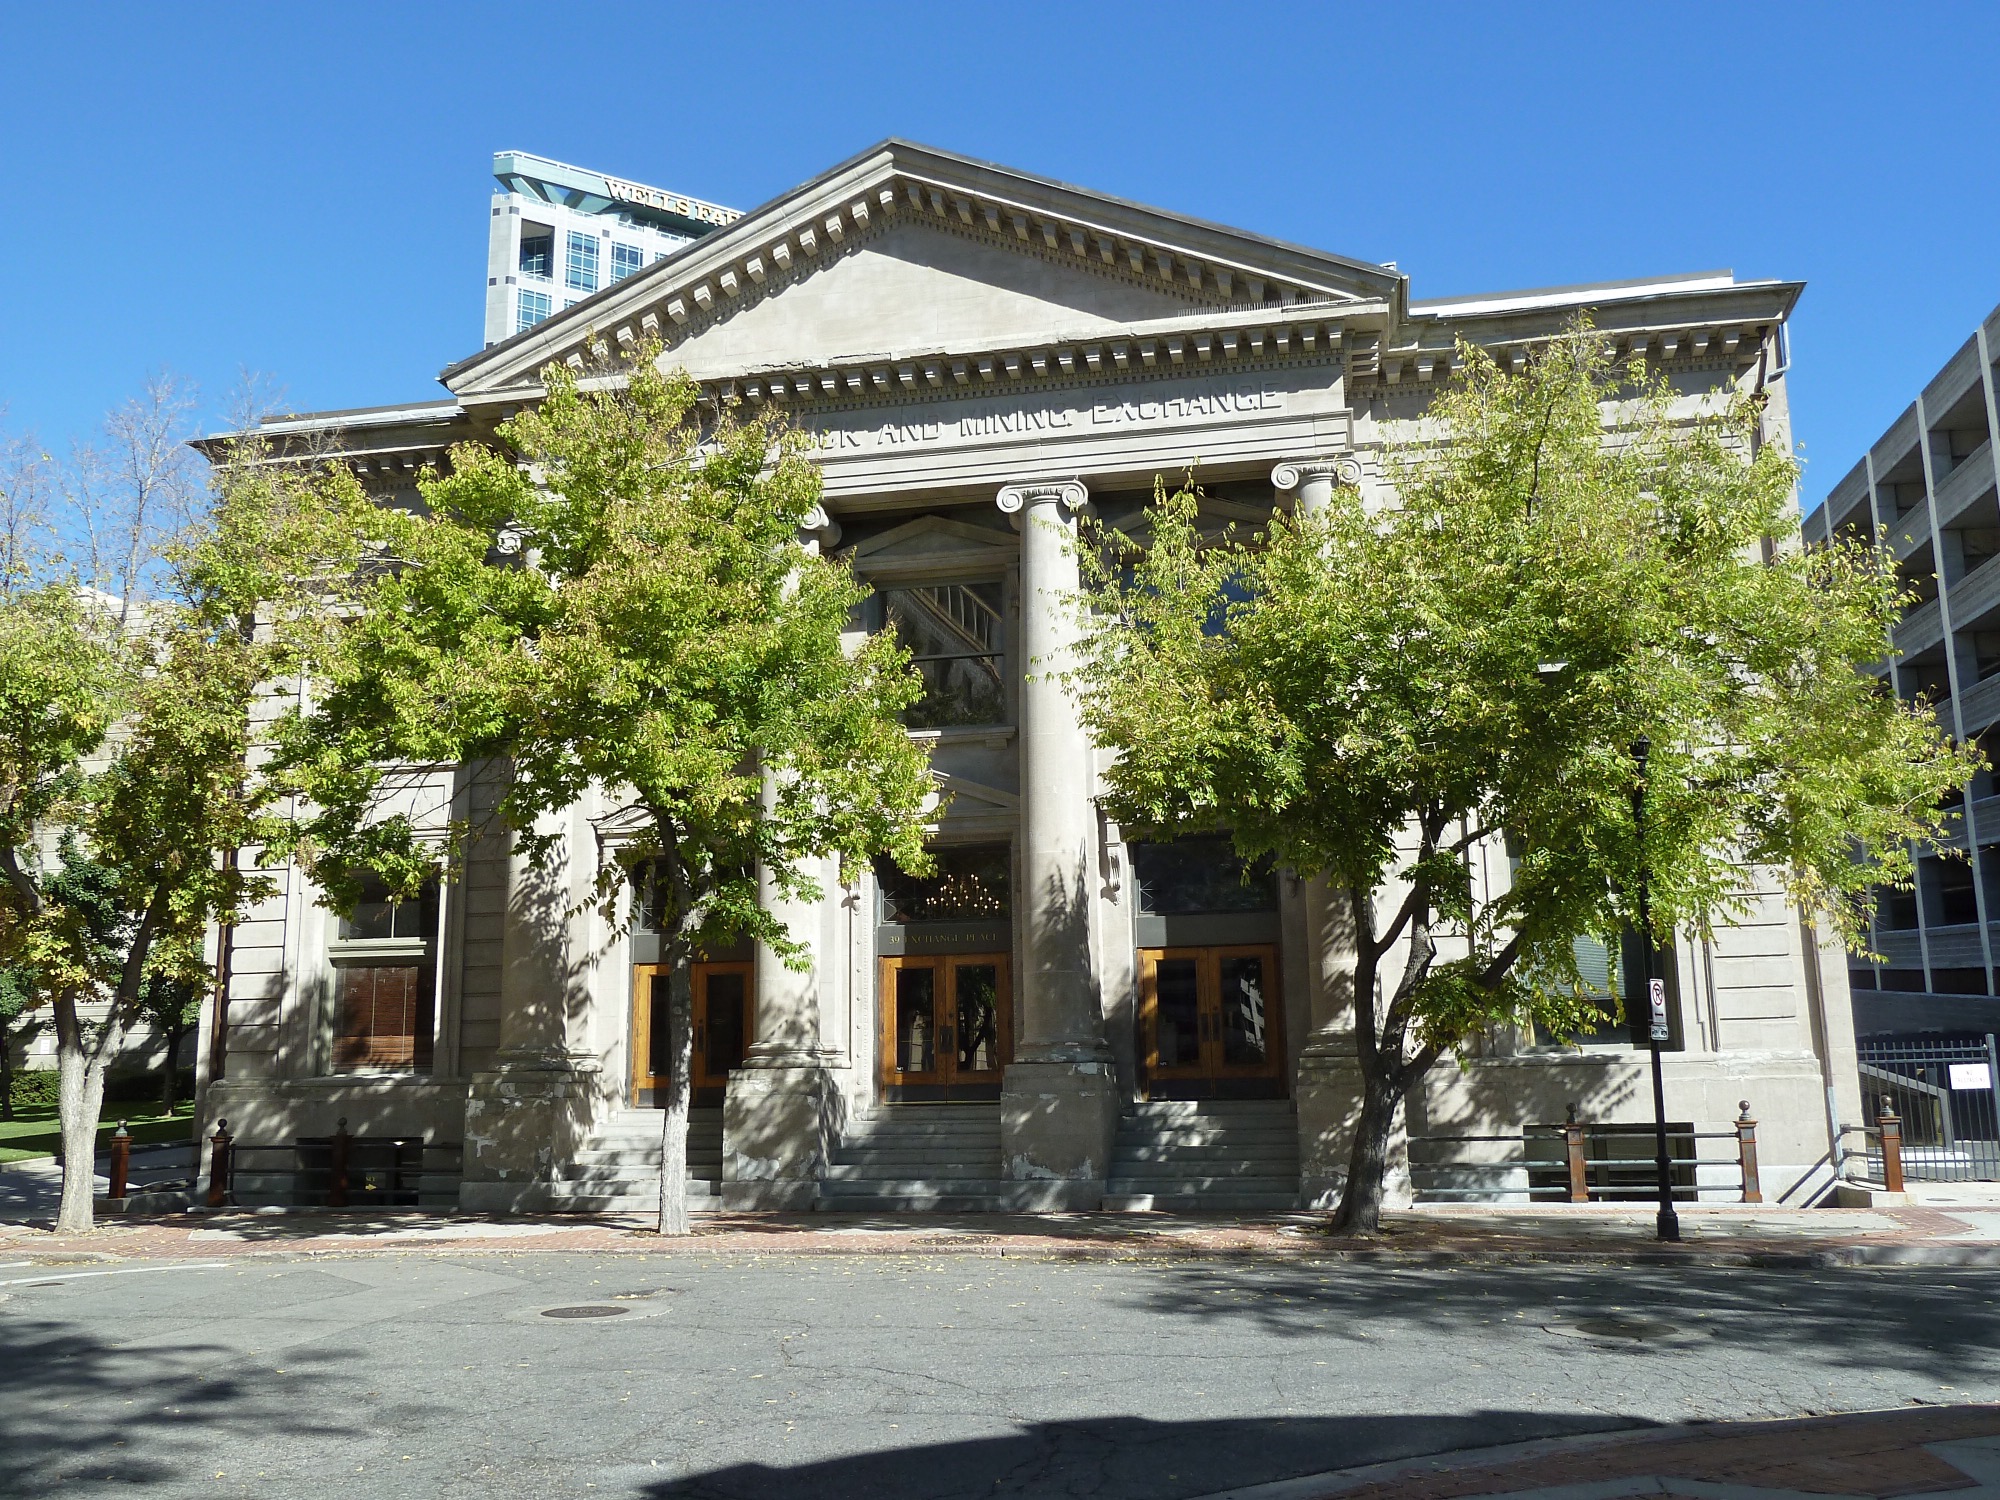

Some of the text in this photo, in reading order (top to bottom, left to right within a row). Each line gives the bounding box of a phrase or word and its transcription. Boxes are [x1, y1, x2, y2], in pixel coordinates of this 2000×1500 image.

[605, 180, 742, 228] WELLS FAR
[877, 414, 943, 445] AND
[960, 401, 1074, 438] MINING
[1092, 381, 1283, 425] EXCHANGE
[889, 935, 900, 945] 39
